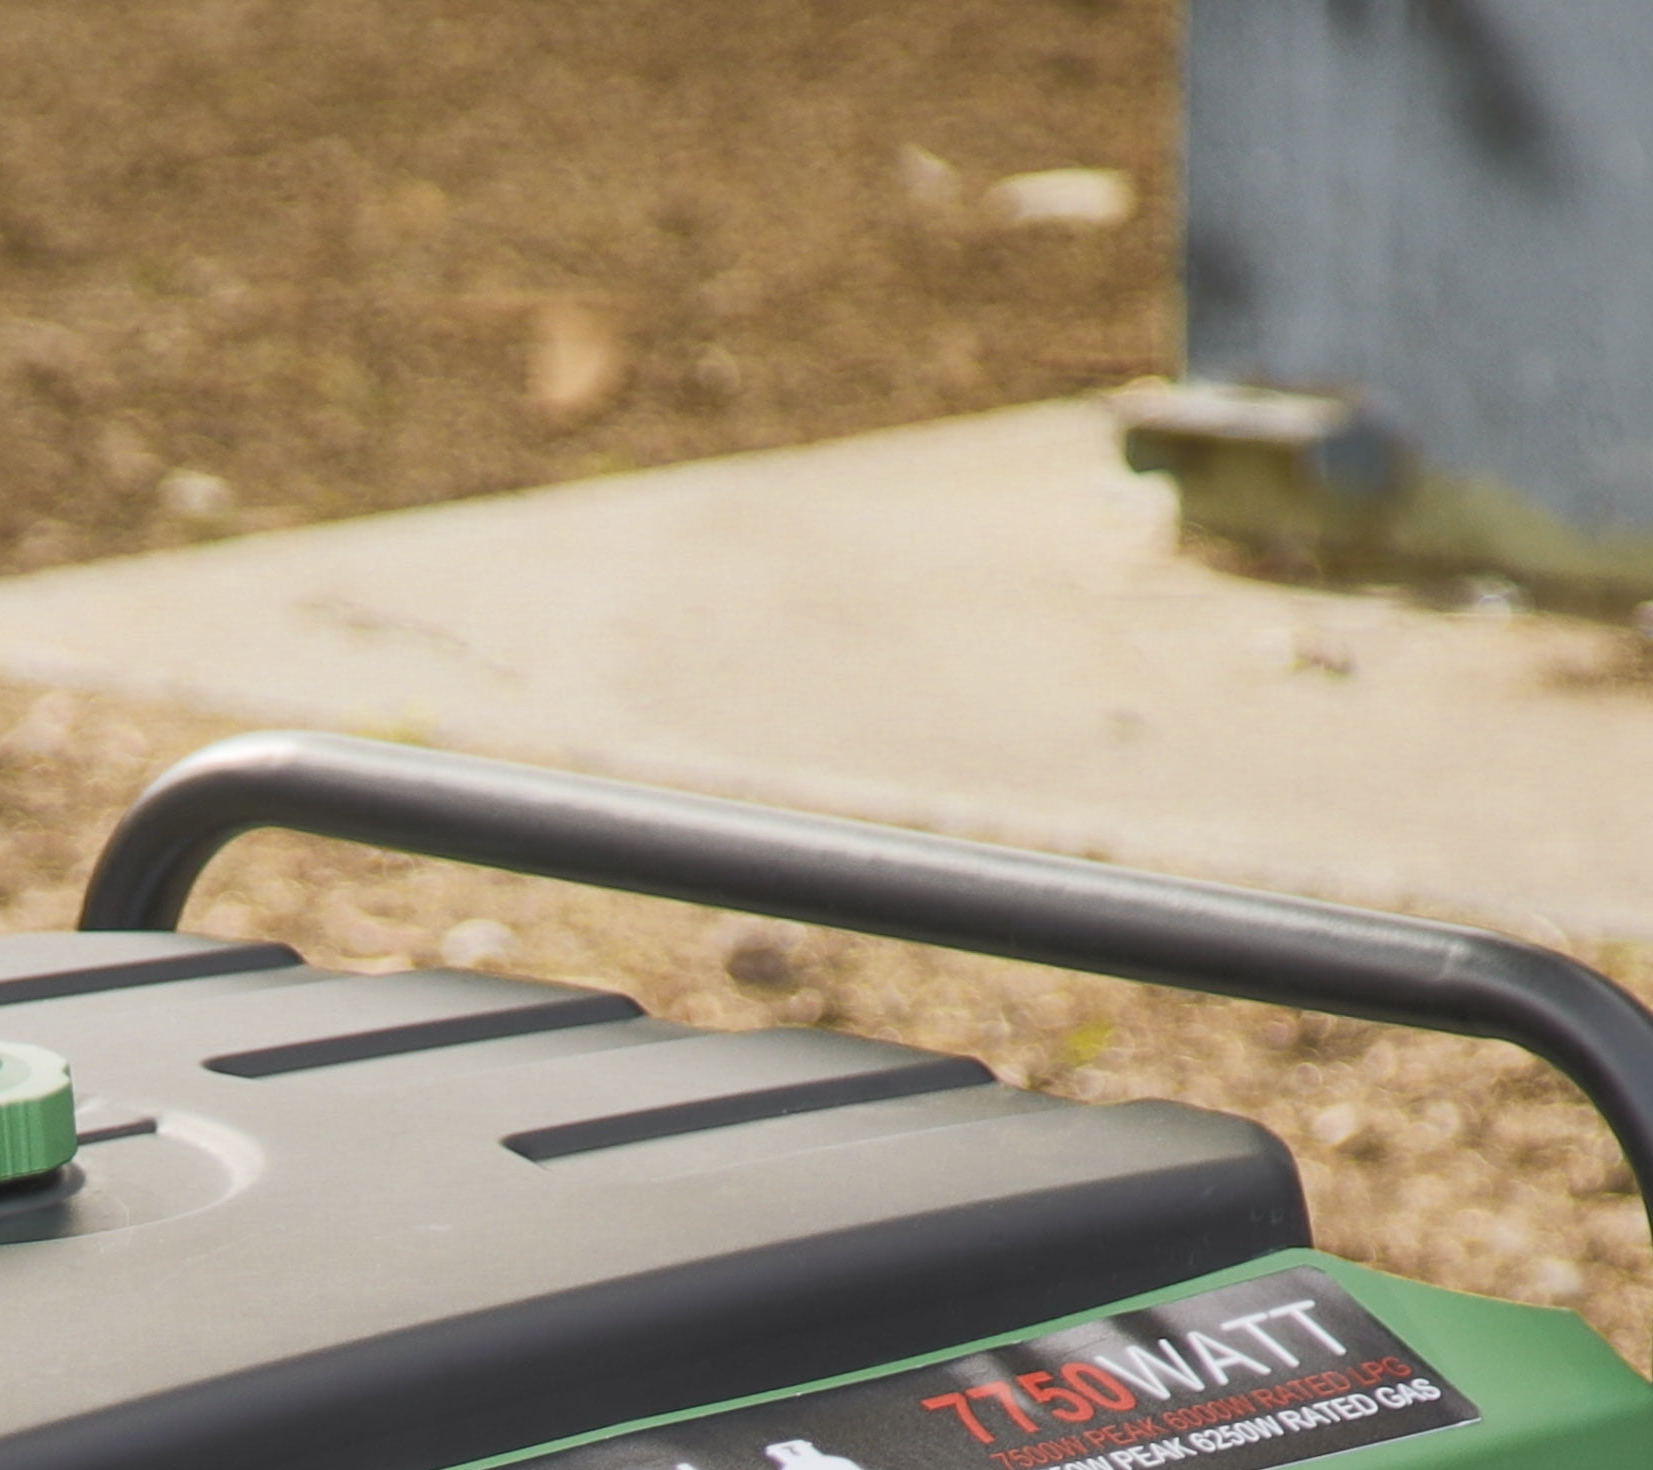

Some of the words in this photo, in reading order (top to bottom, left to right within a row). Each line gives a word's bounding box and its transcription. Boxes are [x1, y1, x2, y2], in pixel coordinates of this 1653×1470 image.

[1081, 1419, 1169, 1454] PEAK
[1255, 1372, 1352, 1411] RATED
[1353, 1357, 1413, 1391] LPG
[1192, 1414, 1286, 1455] 6250W
[1284, 1393, 1378, 1433] RATED
[1376, 1377, 1442, 1414] GAS
